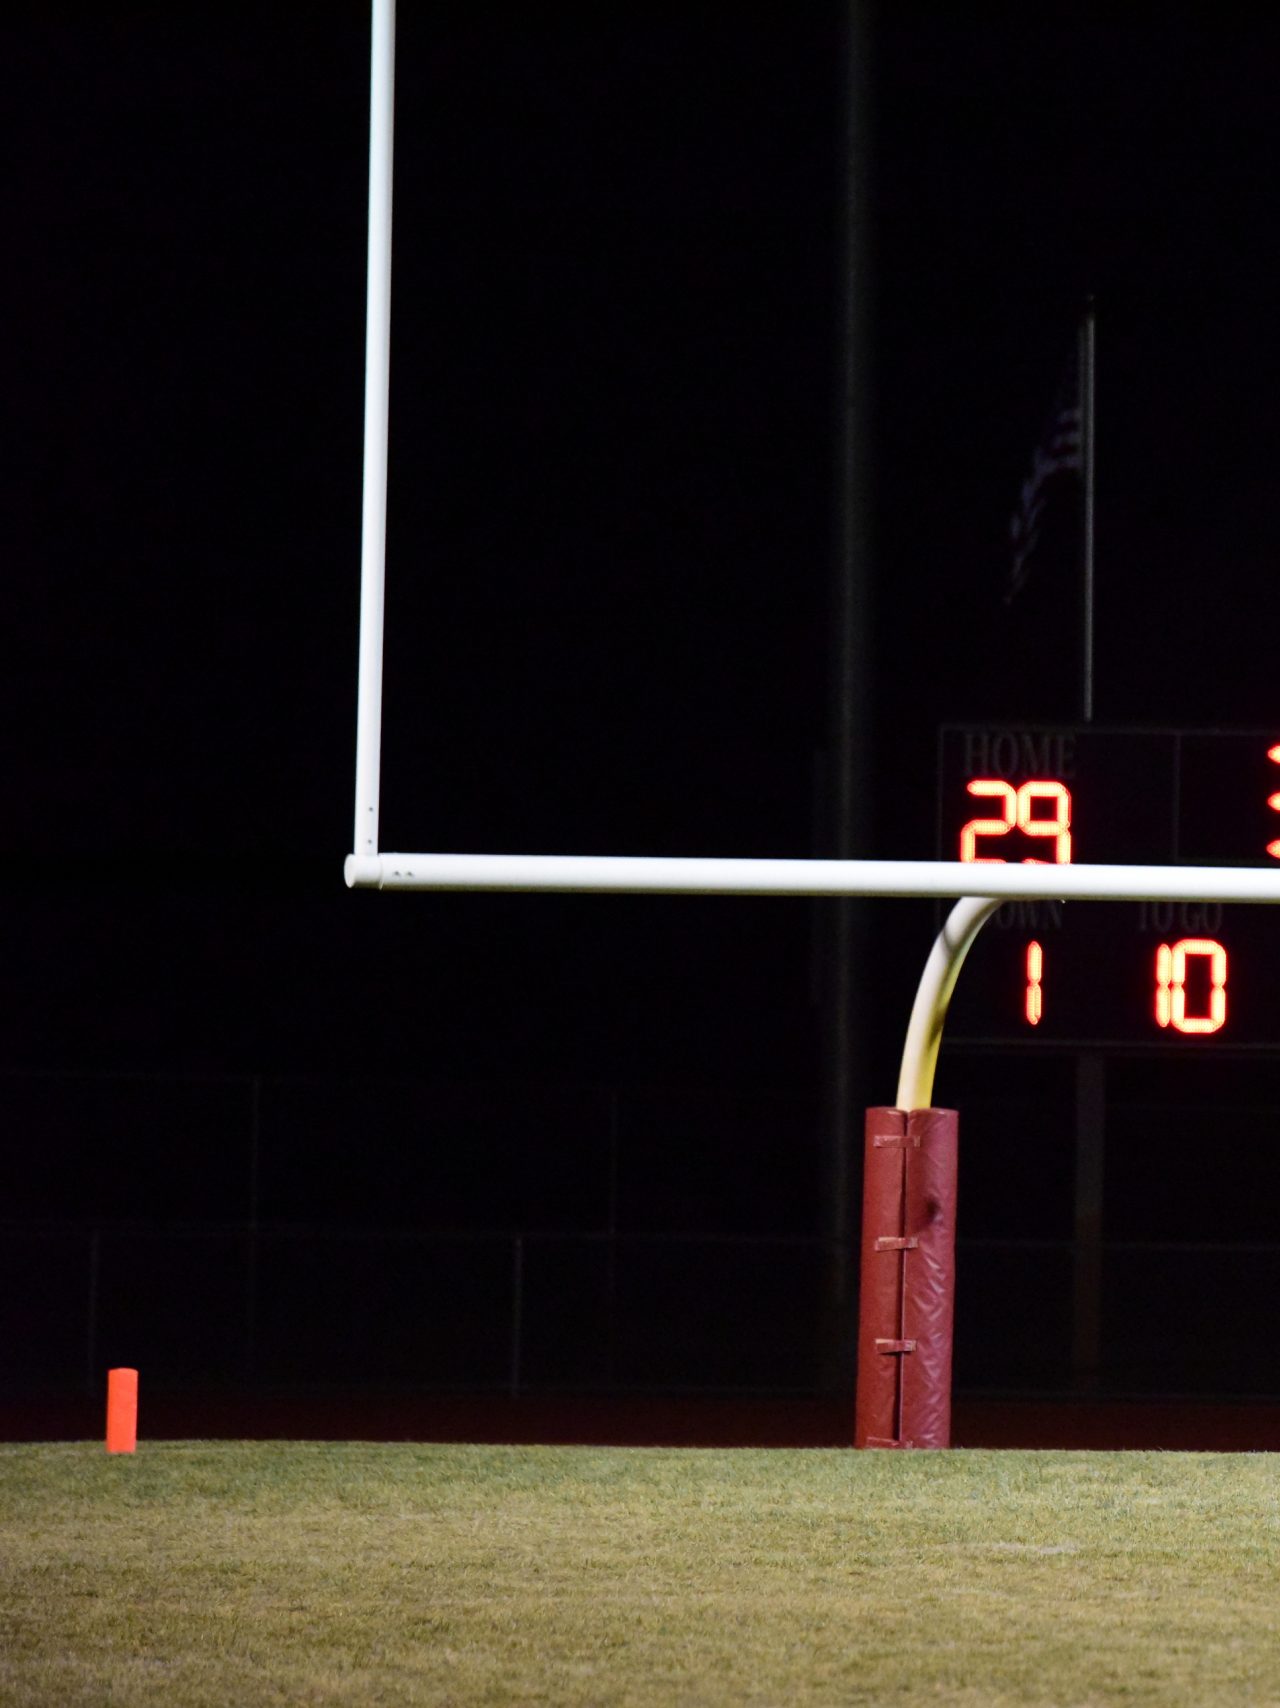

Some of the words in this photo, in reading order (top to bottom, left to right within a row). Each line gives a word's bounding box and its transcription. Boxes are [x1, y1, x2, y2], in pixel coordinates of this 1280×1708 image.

[964, 731, 1077, 779] HOME
[960, 778, 1072, 864] 29
[985, 900, 1062, 930] OWN
[1025, 941, 1043, 1025] 1
[1154, 937, 1229, 1034] 10
